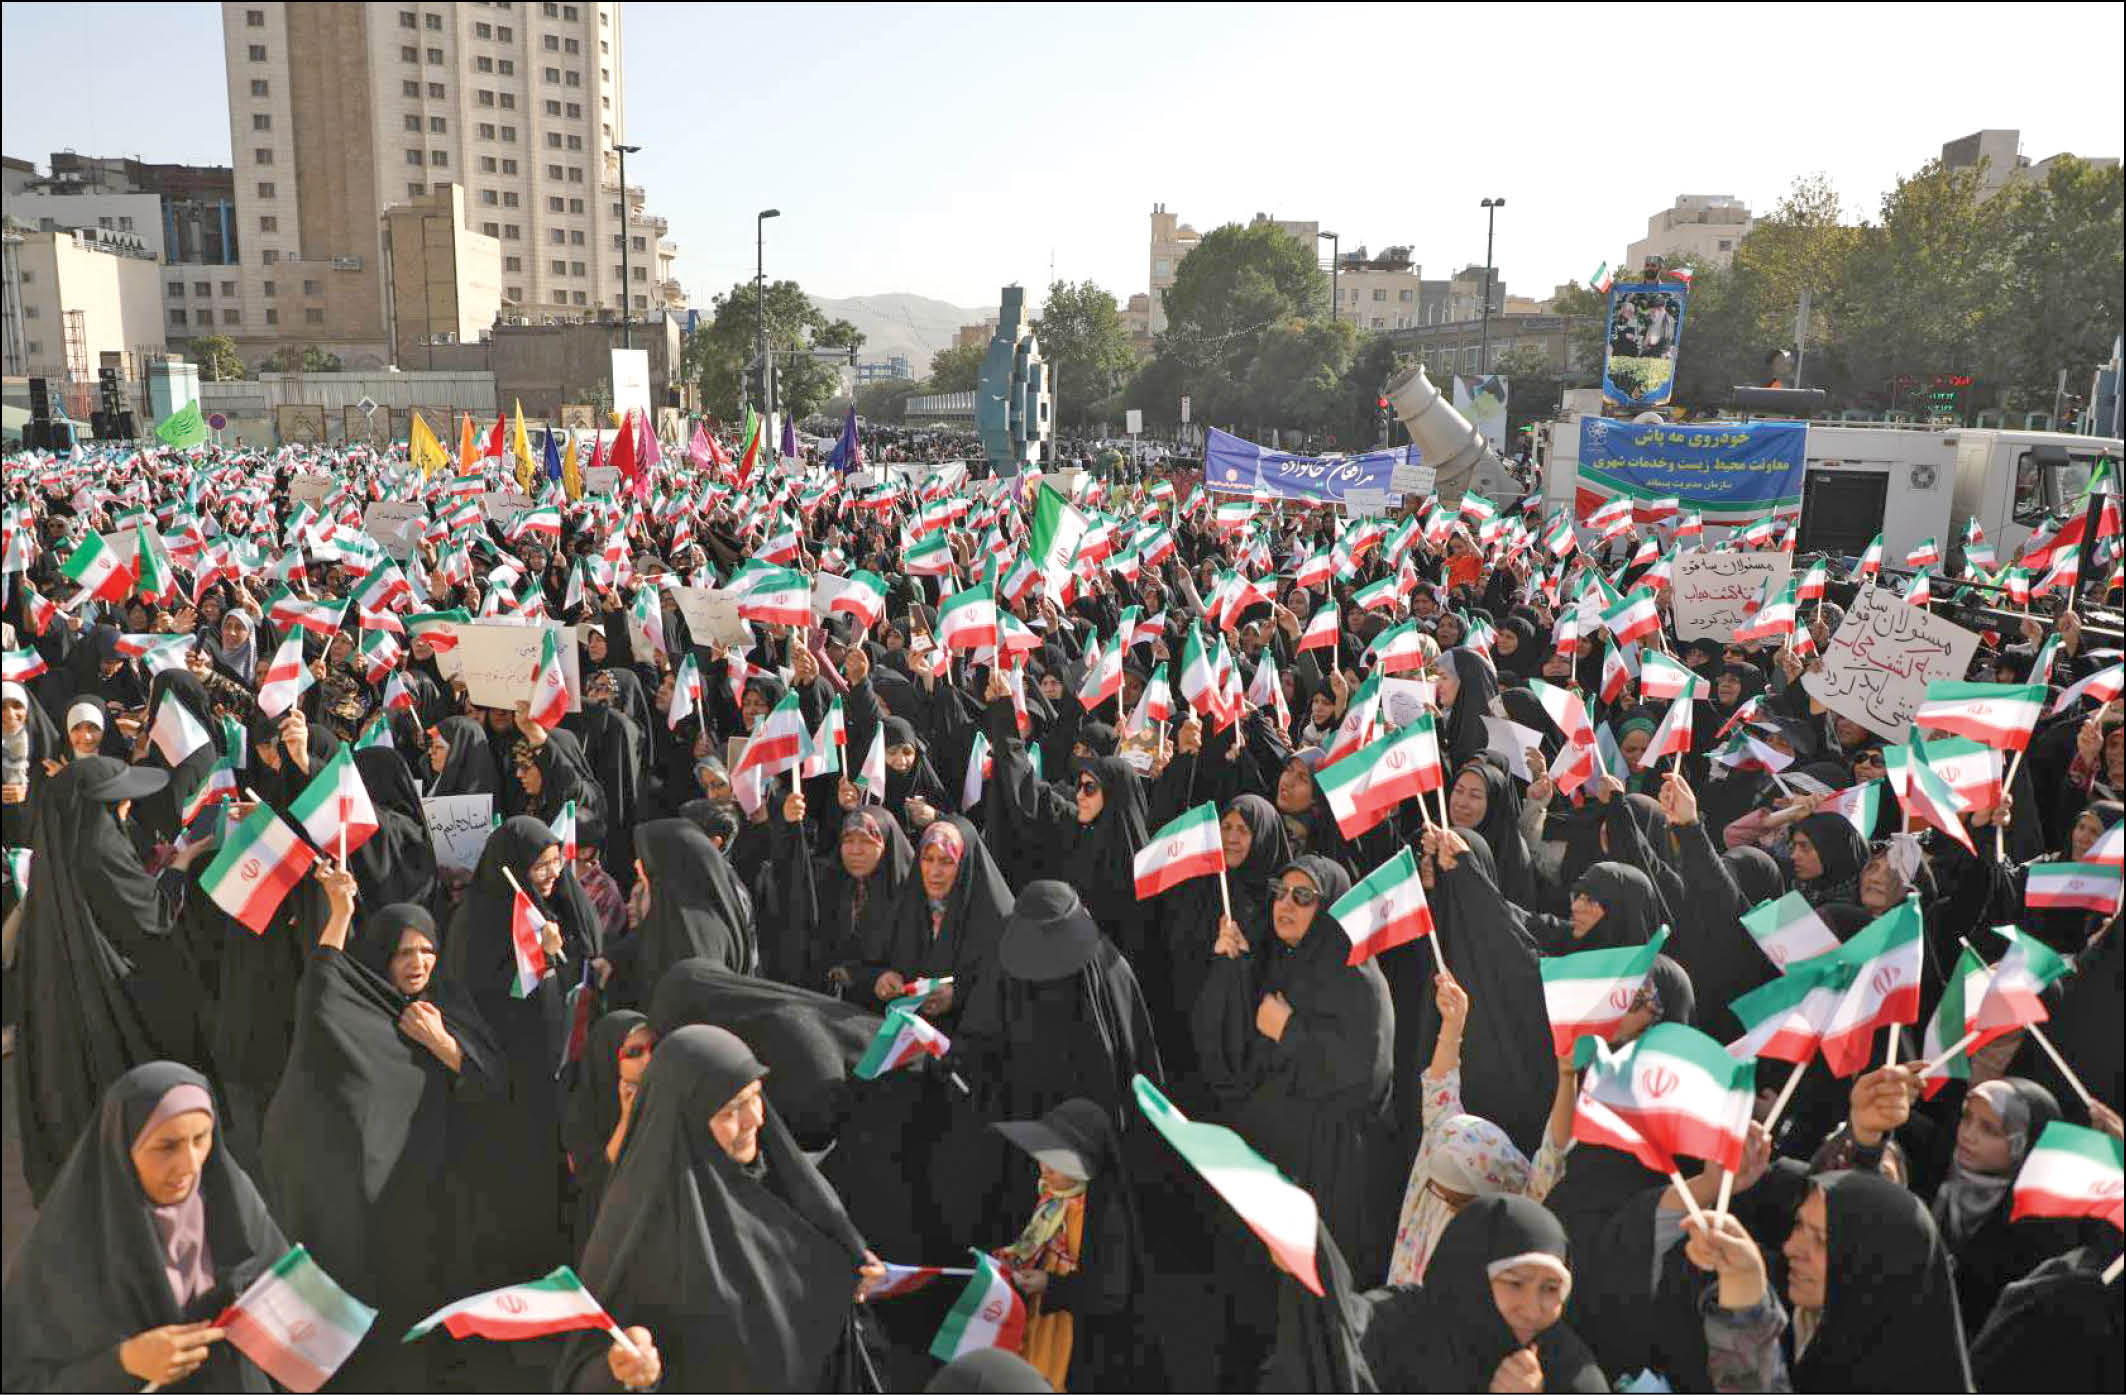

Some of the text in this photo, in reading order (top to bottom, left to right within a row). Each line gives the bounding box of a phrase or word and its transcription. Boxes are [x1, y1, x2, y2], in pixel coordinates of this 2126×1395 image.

[1279, 458, 1325, 478] خانواده
[1593, 455, 1625, 470] شهری
[1679, 459, 1710, 474] زیست
[1715, 457, 1747, 472] محیط
[1750, 457, 1790, 473] معاونت
[1713, 557, 1775, 576] مسئولان
[1873, 608, 1952, 657] مسئولان
[1833, 623, 1876, 662] حجاب
